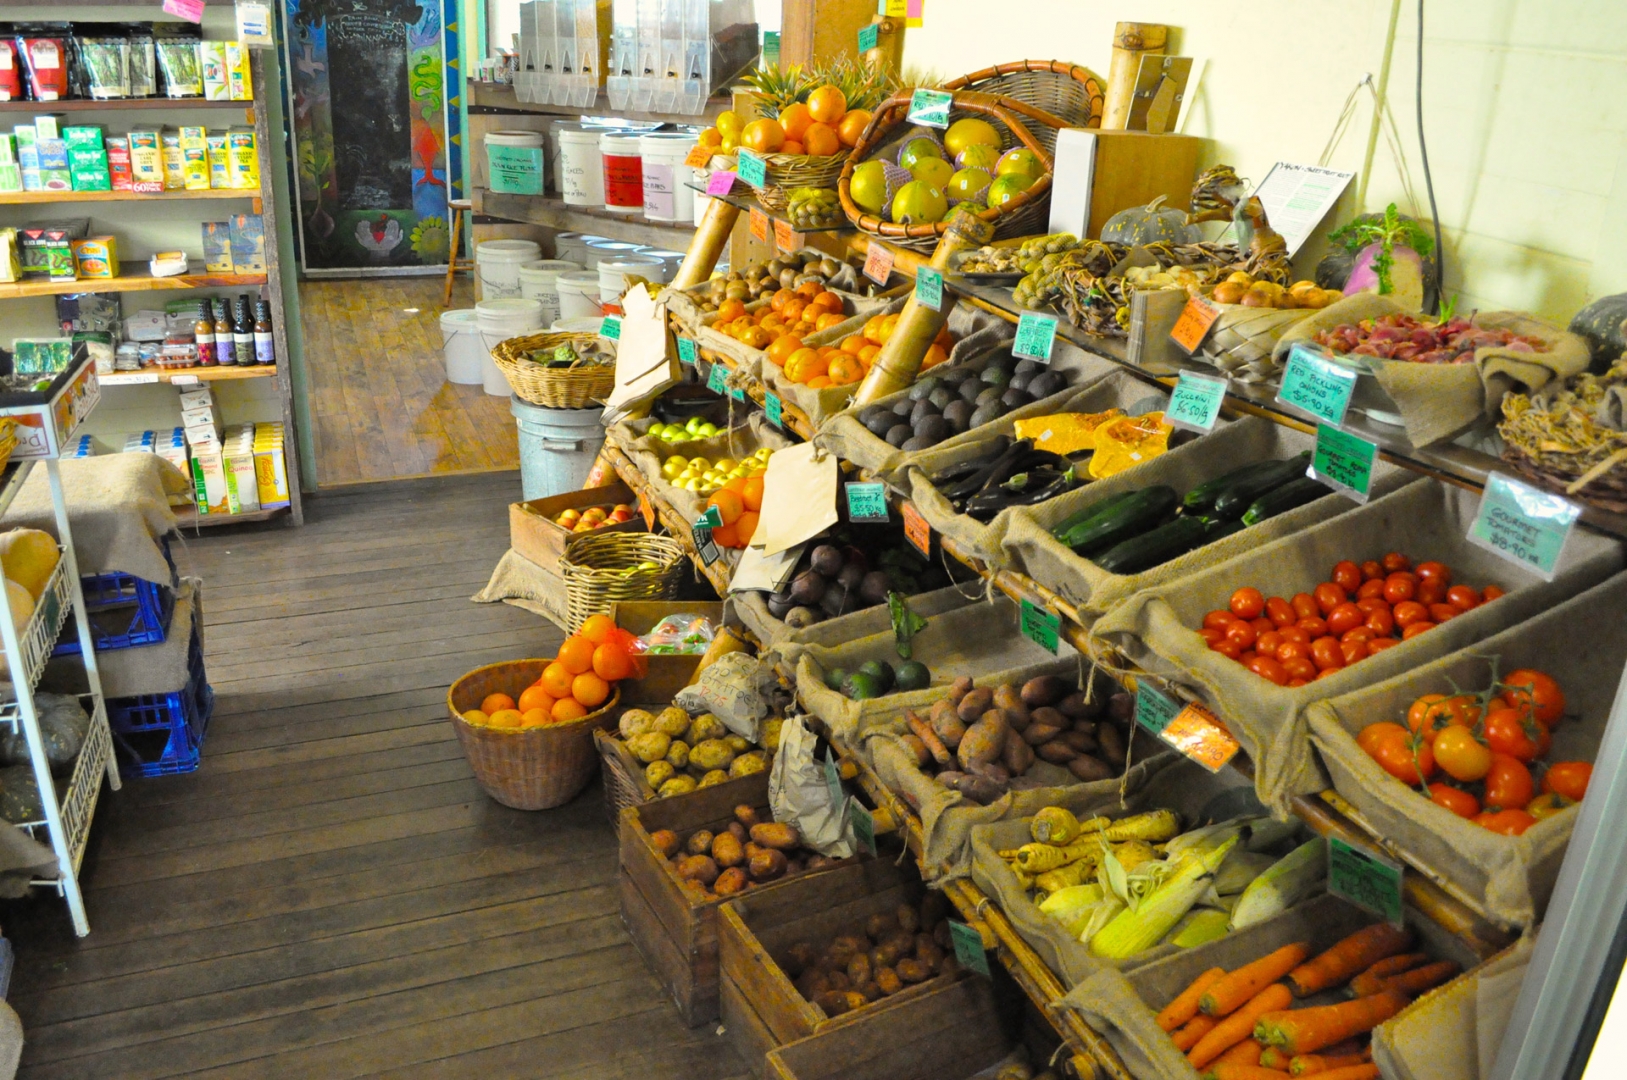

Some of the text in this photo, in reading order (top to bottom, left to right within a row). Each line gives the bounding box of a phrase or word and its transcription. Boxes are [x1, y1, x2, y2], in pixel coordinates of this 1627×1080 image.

[133, 182, 146, 192] 60
[1291, 364, 1305, 377] RED
[1310, 373, 1343, 395] PICKLING
[1299, 381, 1327, 398] ONIONS
[228, 465, 254, 473] Quinoa
[1487, 516, 1536, 547] TOMATOES
[1491, 507, 1542, 537] GOURMET
[1490, 531, 1526, 559] $8.90
